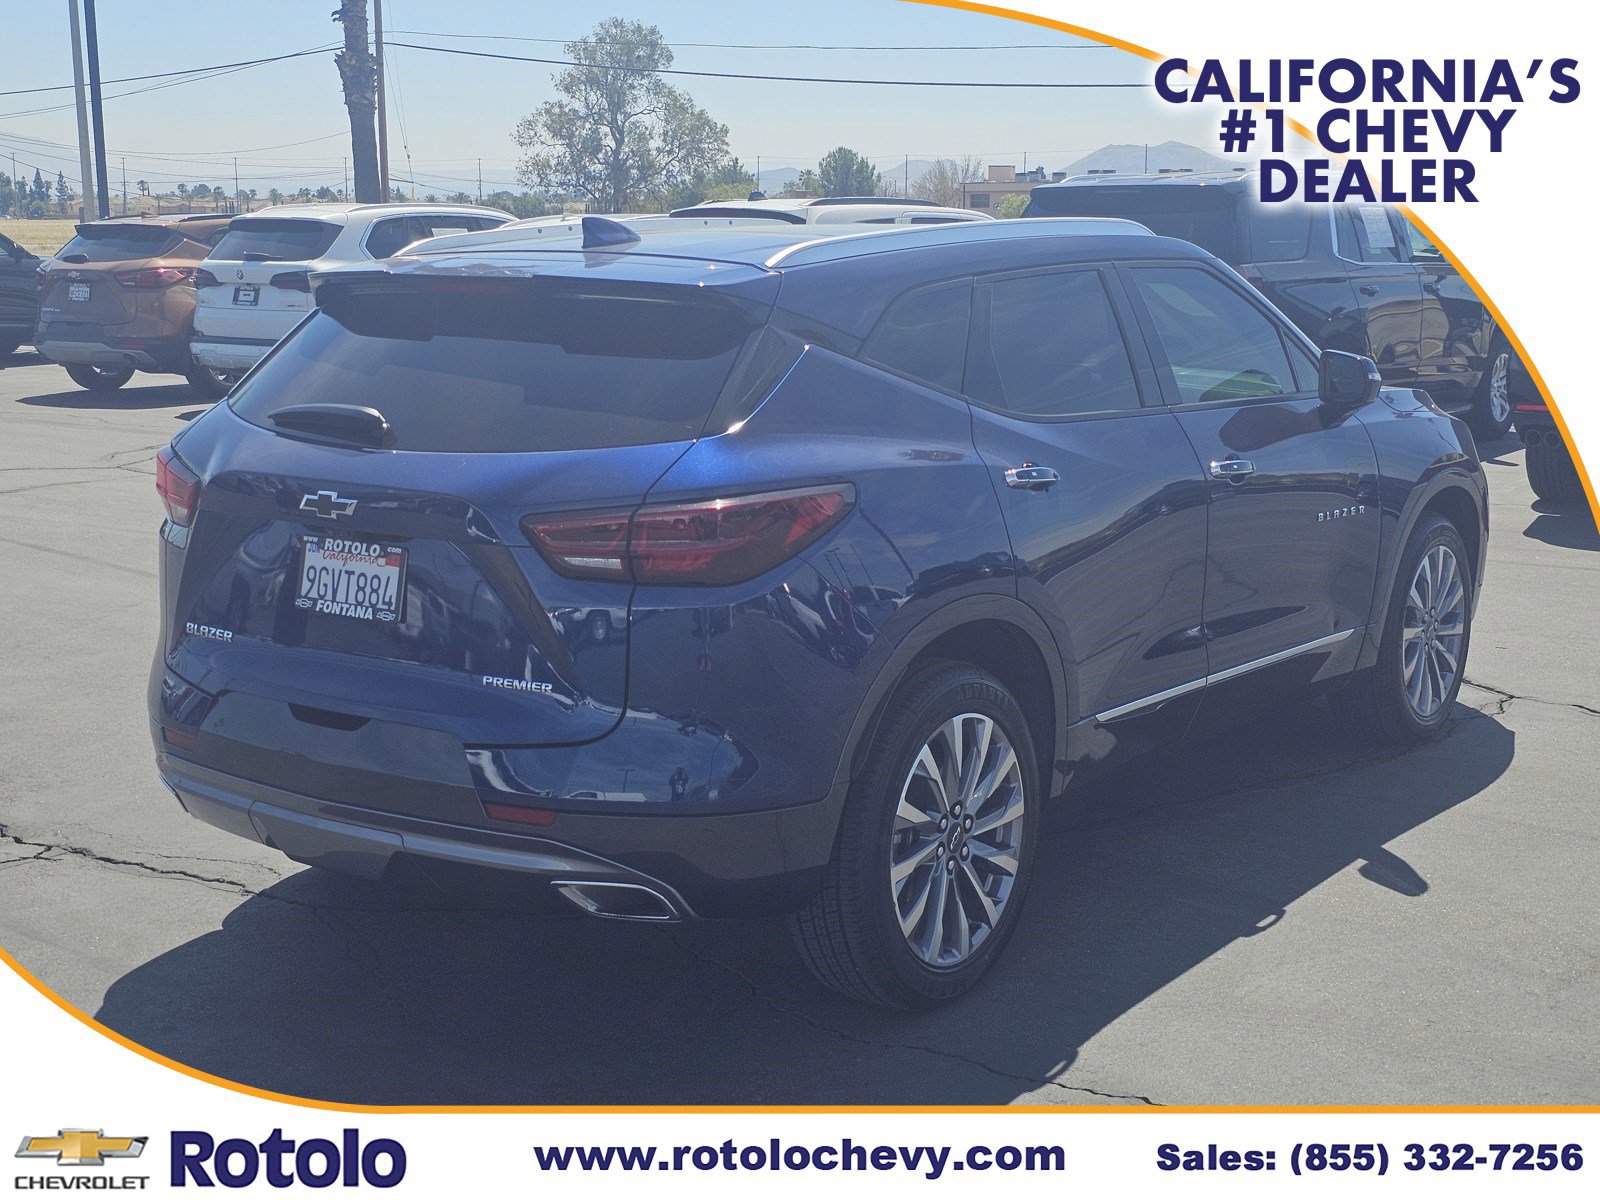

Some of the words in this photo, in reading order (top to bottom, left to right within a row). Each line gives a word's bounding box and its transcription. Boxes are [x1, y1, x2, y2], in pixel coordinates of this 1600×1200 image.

[1317, 505, 1365, 522] BLAZER
[324, 538, 381, 557] ROTOLO
[303, 565, 394, 609] 9GVT884
[315, 600, 374, 620] FONTANA
[186, 622, 233, 643] BLAZER
[482, 675, 553, 694] PREMIER
